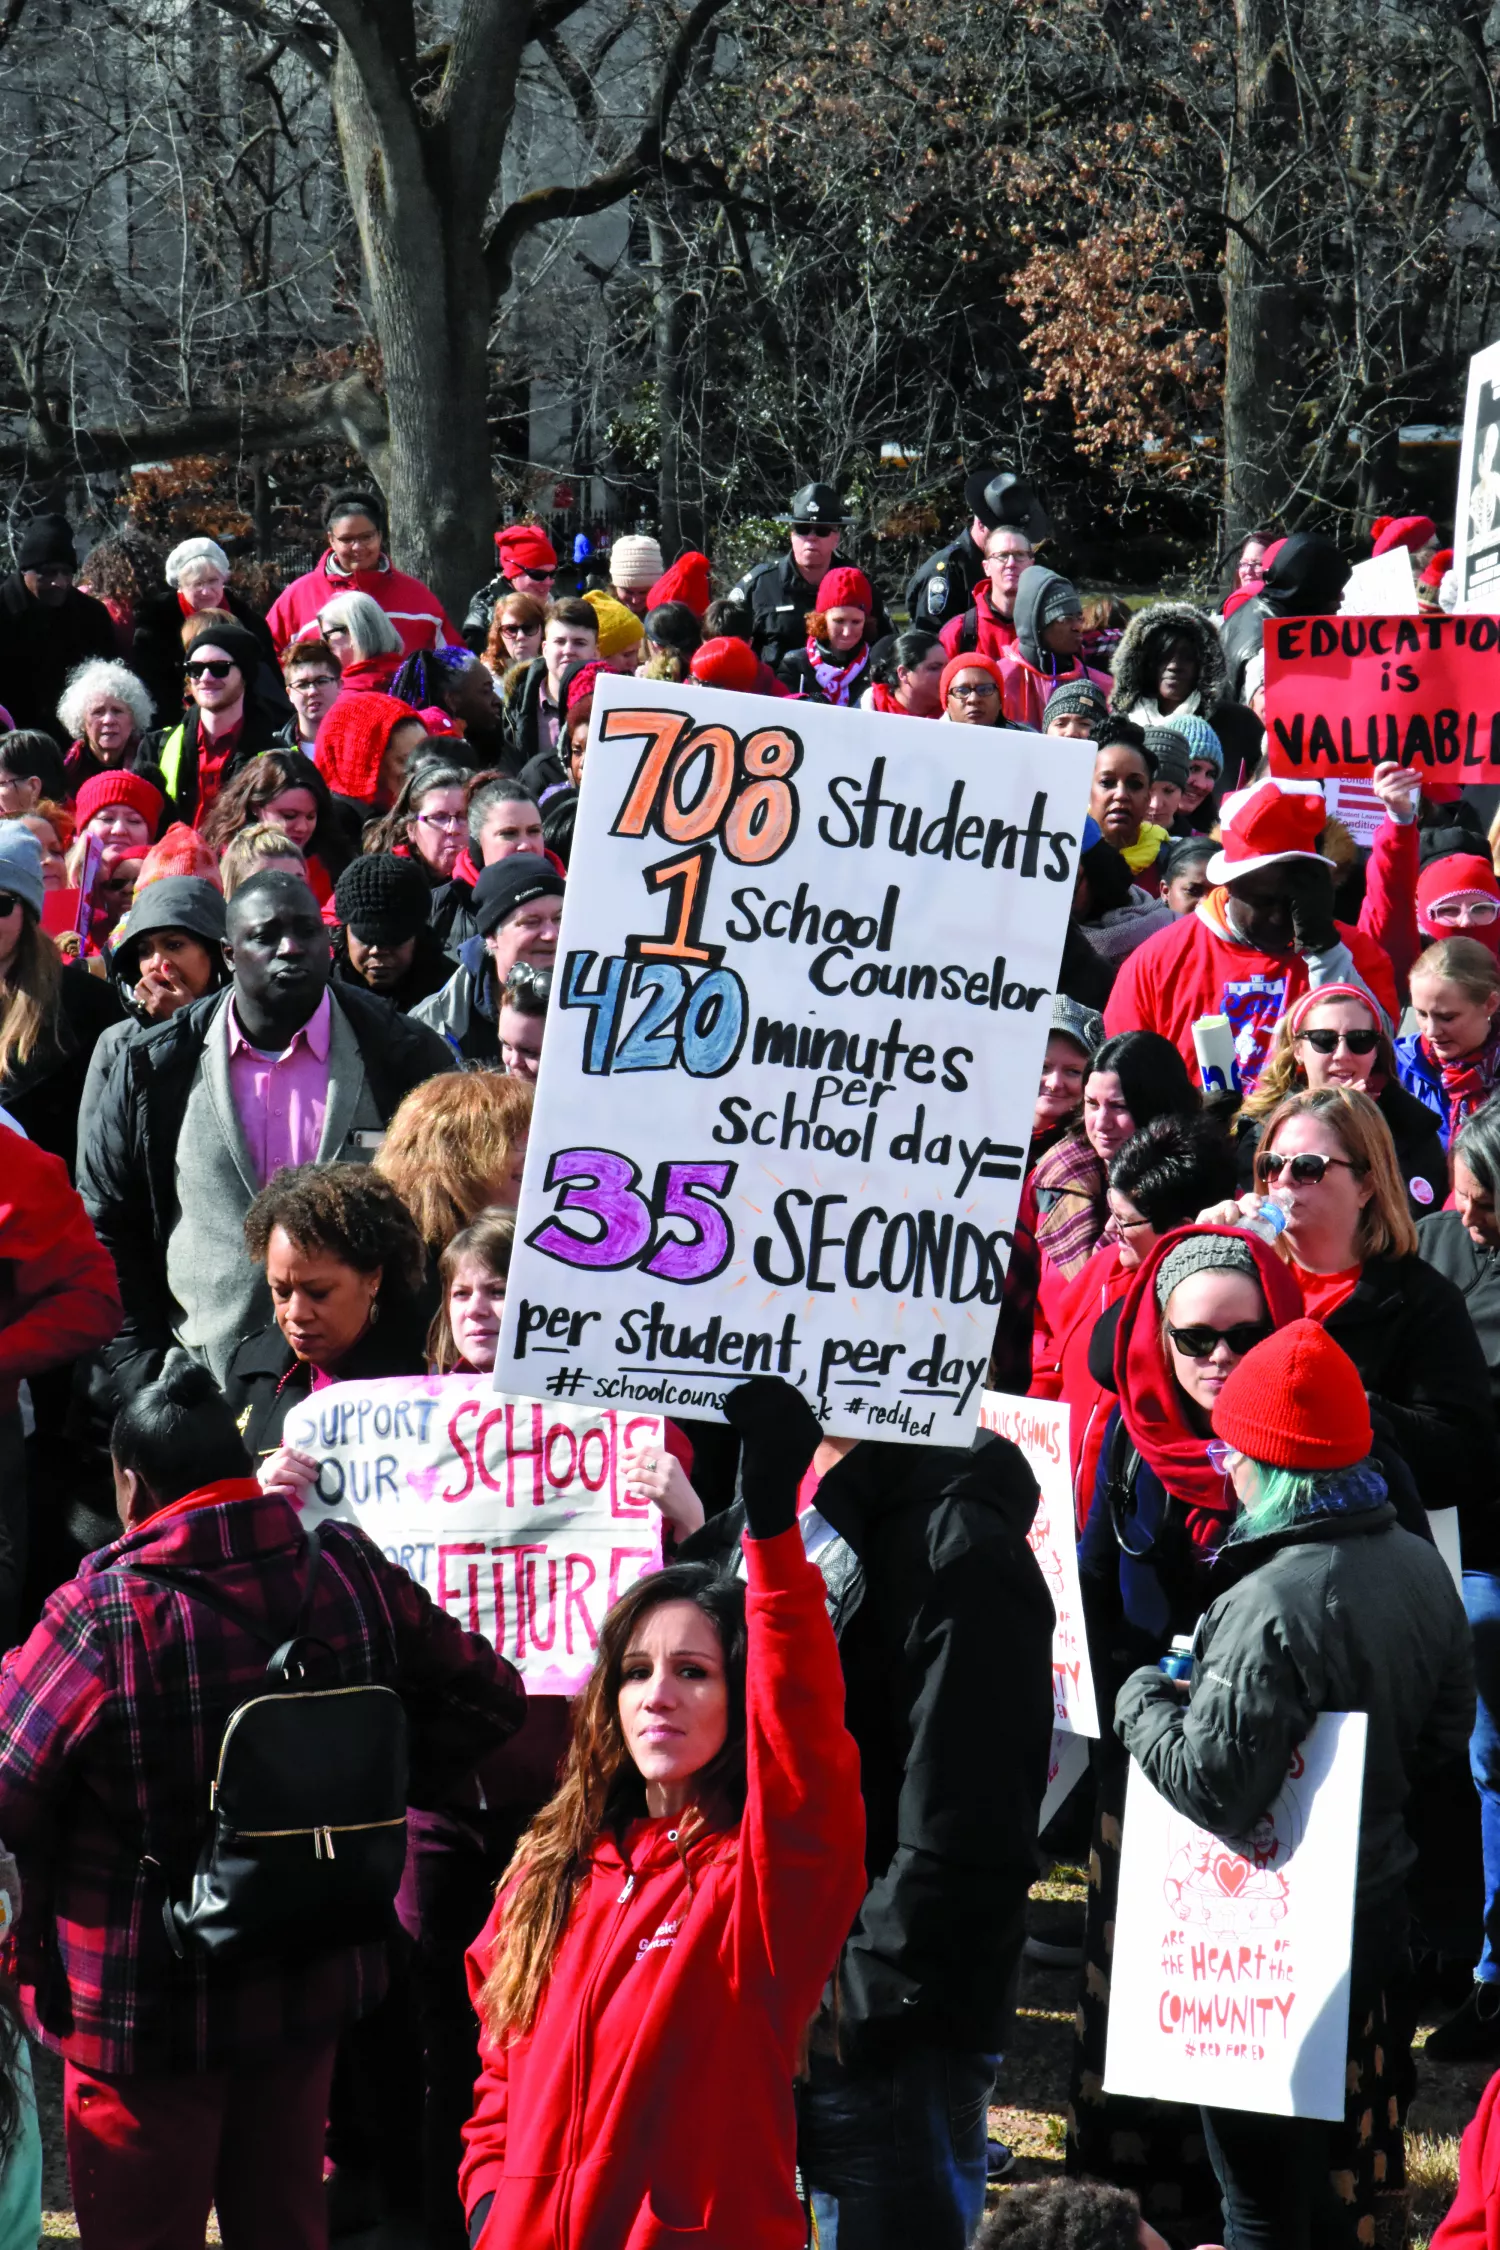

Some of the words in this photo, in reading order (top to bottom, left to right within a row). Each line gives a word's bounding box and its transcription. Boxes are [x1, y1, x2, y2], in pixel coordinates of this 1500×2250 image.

[1276, 616, 1500, 660] EDUCATIO
[599, 707, 805, 867] 708
[817, 756, 1078, 884] Students
[1361, 812, 1385, 821] Learnin
[625, 842, 726, 967] 1
[725, 882, 900, 951] School
[808, 945, 1051, 1013] Counselor
[559, 948, 749, 1078] 420
[752, 1010, 974, 1093] minutes
[808, 1075, 897, 1124] per
[524, 1146, 738, 1286] 35
[753, 1187, 1016, 1305] SECONDS
[513, 1298, 602, 1360] per
[817, 1336, 906, 1397] per
[295, 1399, 439, 1450] SUPPORT
[1014, 1411, 1061, 1465] SCHOOLS
[314, 1455, 400, 1507] OUR
[1268, 1957, 1294, 1983] the
[1273, 1939, 1291, 1952] OF
[1159, 1989, 1296, 2040] COMMUNITY
[1226, 2043, 1248, 2060] FOR
[1251, 2044, 1265, 2061] ED
